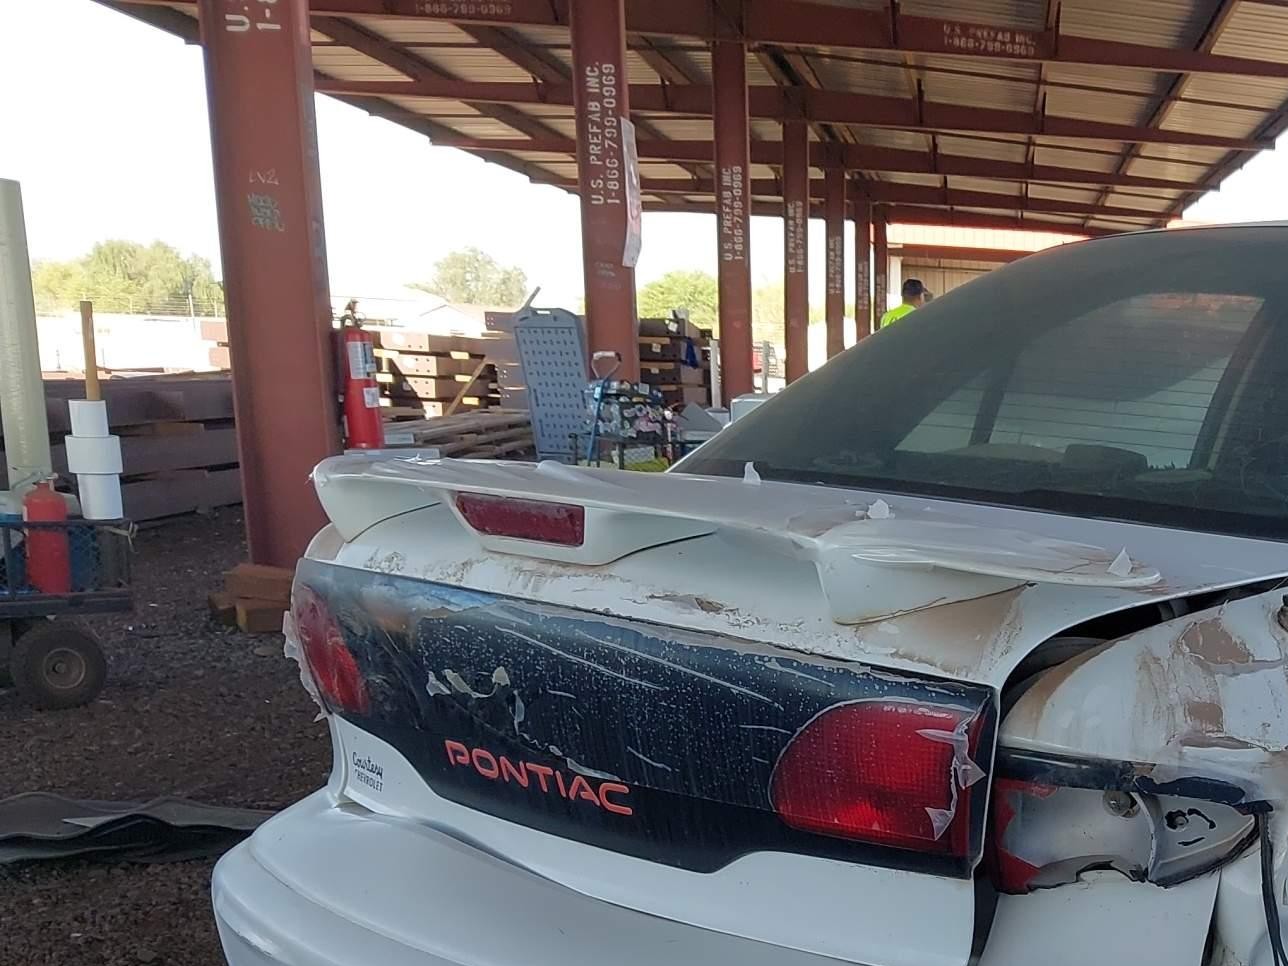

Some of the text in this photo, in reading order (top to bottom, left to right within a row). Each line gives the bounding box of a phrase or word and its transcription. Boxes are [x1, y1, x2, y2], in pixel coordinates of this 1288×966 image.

[585, 61, 604, 205] U.S. PREFAB INC.
[601, 63, 621, 205] 1-866-799-0969
[722, 191, 733, 235] PREFAB
[732, 165, 745, 260] 1-866-799-0969
[352, 751, 384, 780] Courtesy
[444, 739, 633, 815] PONTIAC
